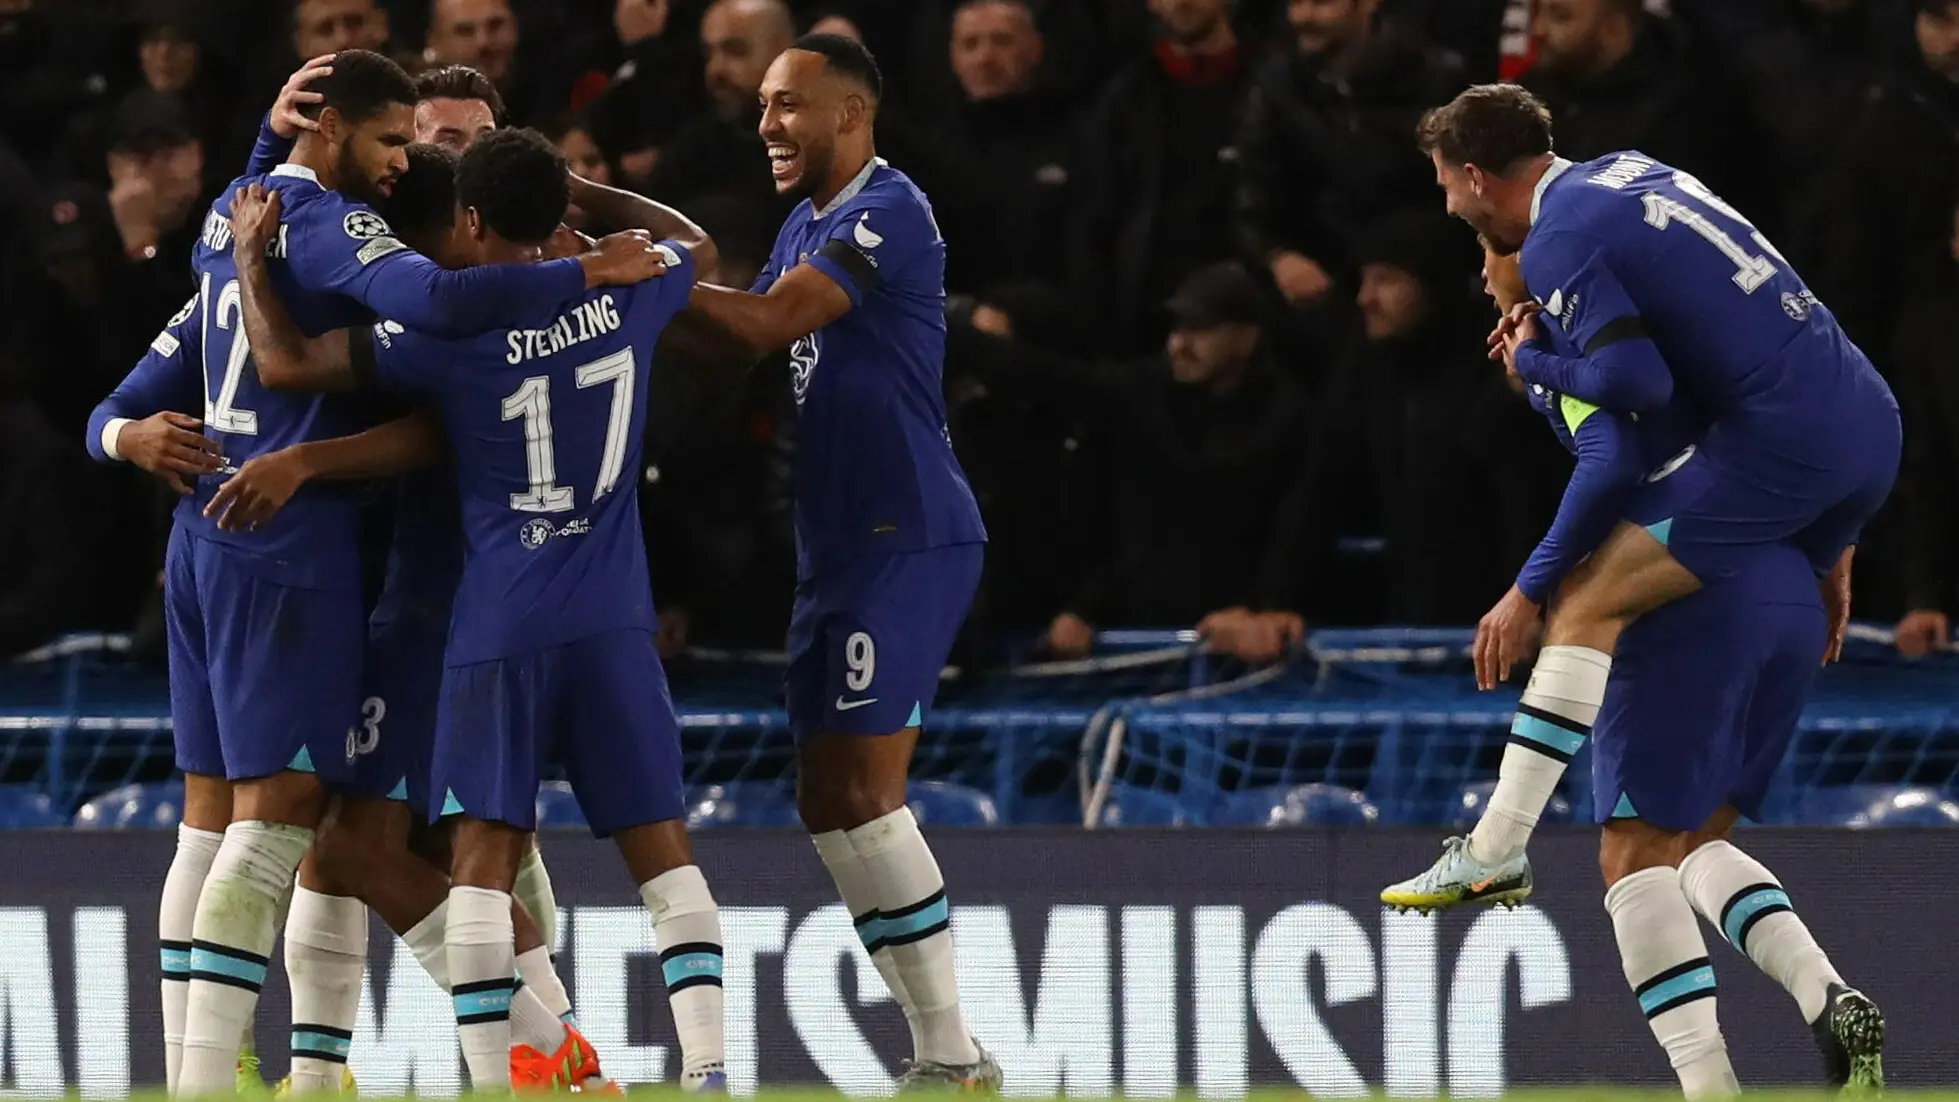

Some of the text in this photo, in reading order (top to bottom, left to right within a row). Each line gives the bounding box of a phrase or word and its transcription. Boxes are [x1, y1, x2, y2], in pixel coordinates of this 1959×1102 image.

[1586, 153, 1655, 190] MOUNT
[505, 293, 622, 365] STERLING
[501, 345, 636, 512] 17
[845, 631, 876, 692] 9
